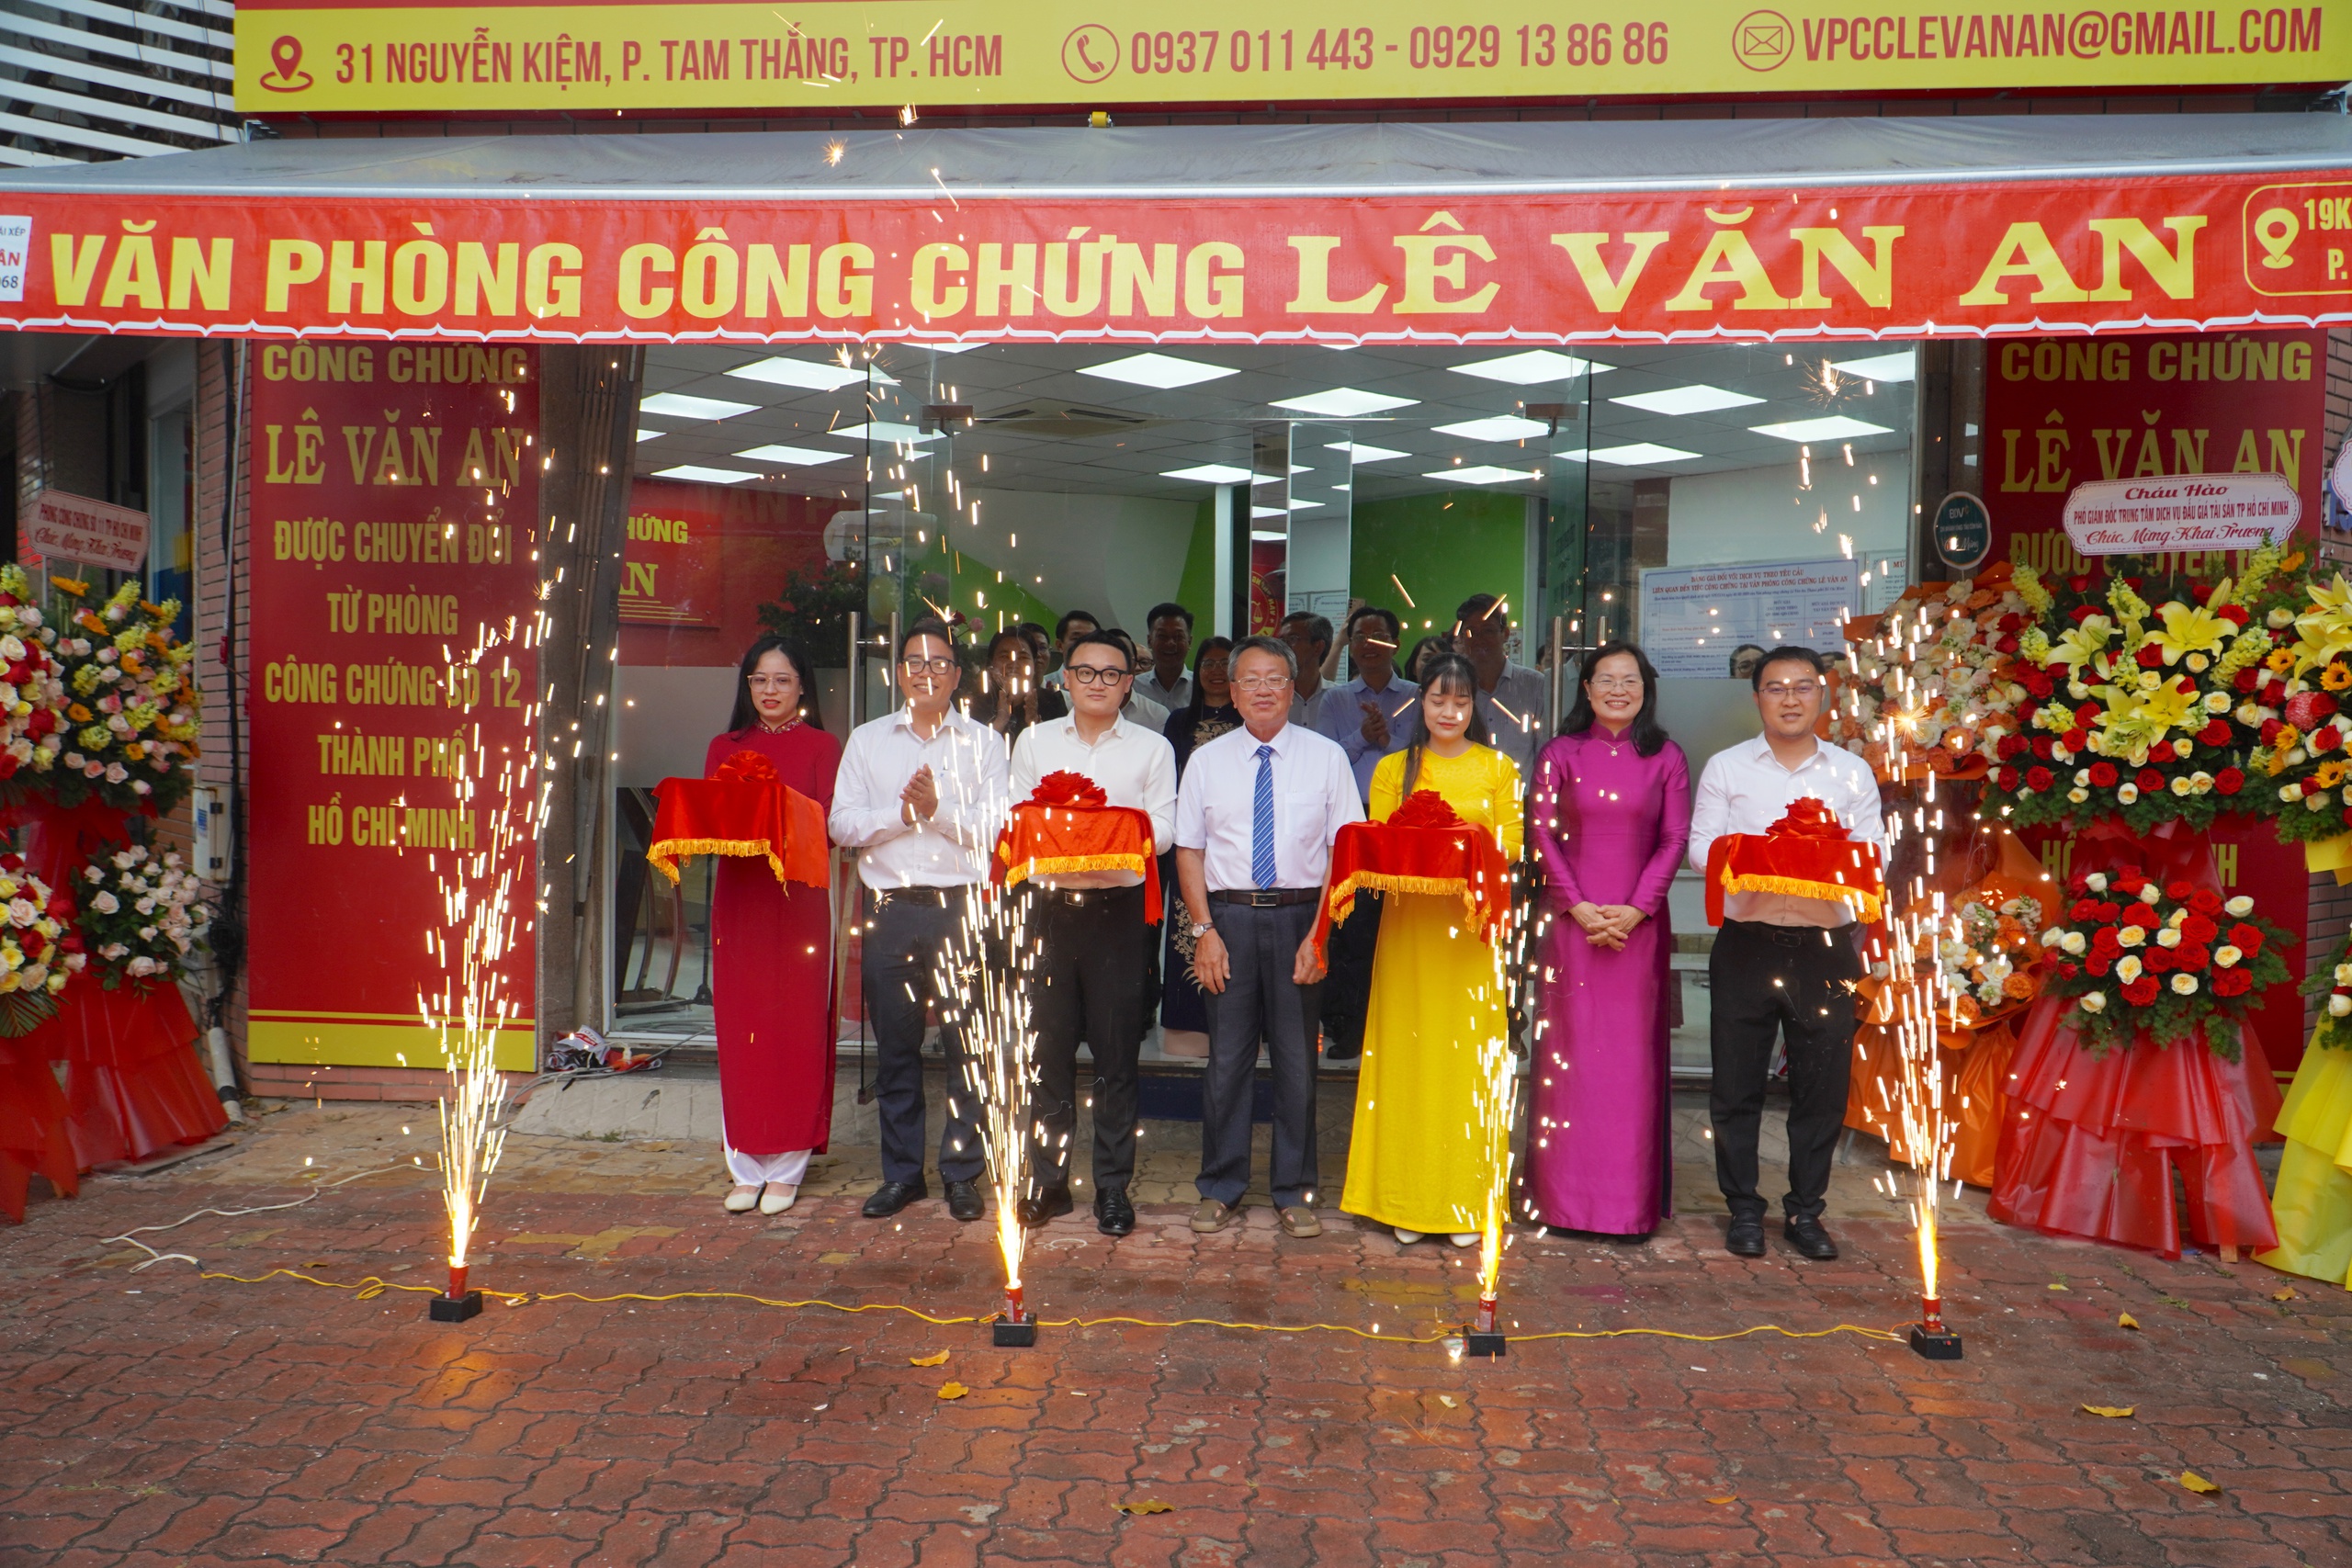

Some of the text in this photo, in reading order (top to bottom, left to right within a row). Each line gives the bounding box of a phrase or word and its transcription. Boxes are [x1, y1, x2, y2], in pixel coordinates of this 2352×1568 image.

[336, 22, 1002, 91] 31 NGUYỄN KIỆM, P. TAM THẮNG, TP. HCM
[1131, 29, 1216, 75] 0937
[1229, 29, 1294, 73] 011
[1306, 28, 1374, 72] 443
[1409, 25, 1501, 69] 0929
[1516, 24, 1556, 67] 13
[1566, 23, 1612, 66] 86
[1623, 21, 1668, 65] 86
[1803, 7, 2323, 62] VPCCLEVANAN@GMAIL.COM
[0, 275, 18, 288] 68
[51, 206, 2208, 320] VĂN PHÒNG CÔNG CHỨNG LÊ VĂN AN
[2328, 248, 2348, 281] P.
[263, 340, 527, 384] CÔNG CHỨNG
[2001, 333, 2312, 381] CÔNG CHỨNG
[265, 406, 525, 487] LÊ VĂN AN
[2000, 409, 2306, 493] LÊ VĂN AN
[2074, 494, 2289, 525] PHÓ GIÁM ĐỐC TRUNG TÂM DỊCH VỤ ĐẤU GIÁ TÀI SẢN TP HỒ CHÍ MINH
[2125, 484, 2229, 500] Cháu Hào
[274, 506, 512, 570] ĐƯỢC CHUYỂN ĐỔI
[627, 513, 688, 544] HỨNG
[2086, 529, 2129, 545] Chúc
[2130, 527, 2170, 546] Mừng
[2171, 525, 2216, 540] Khai
[619, 561, 659, 597] N
[327, 584, 458, 635] TỪ PHÒNG
[266, 654, 337, 703] CÔNG
[346, 656, 436, 705] CHỨNG
[490, 669, 521, 708] 12
[317, 724, 467, 778] THÀNH PHỐ
[308, 792, 476, 849] HỒ CHÍ MINH
